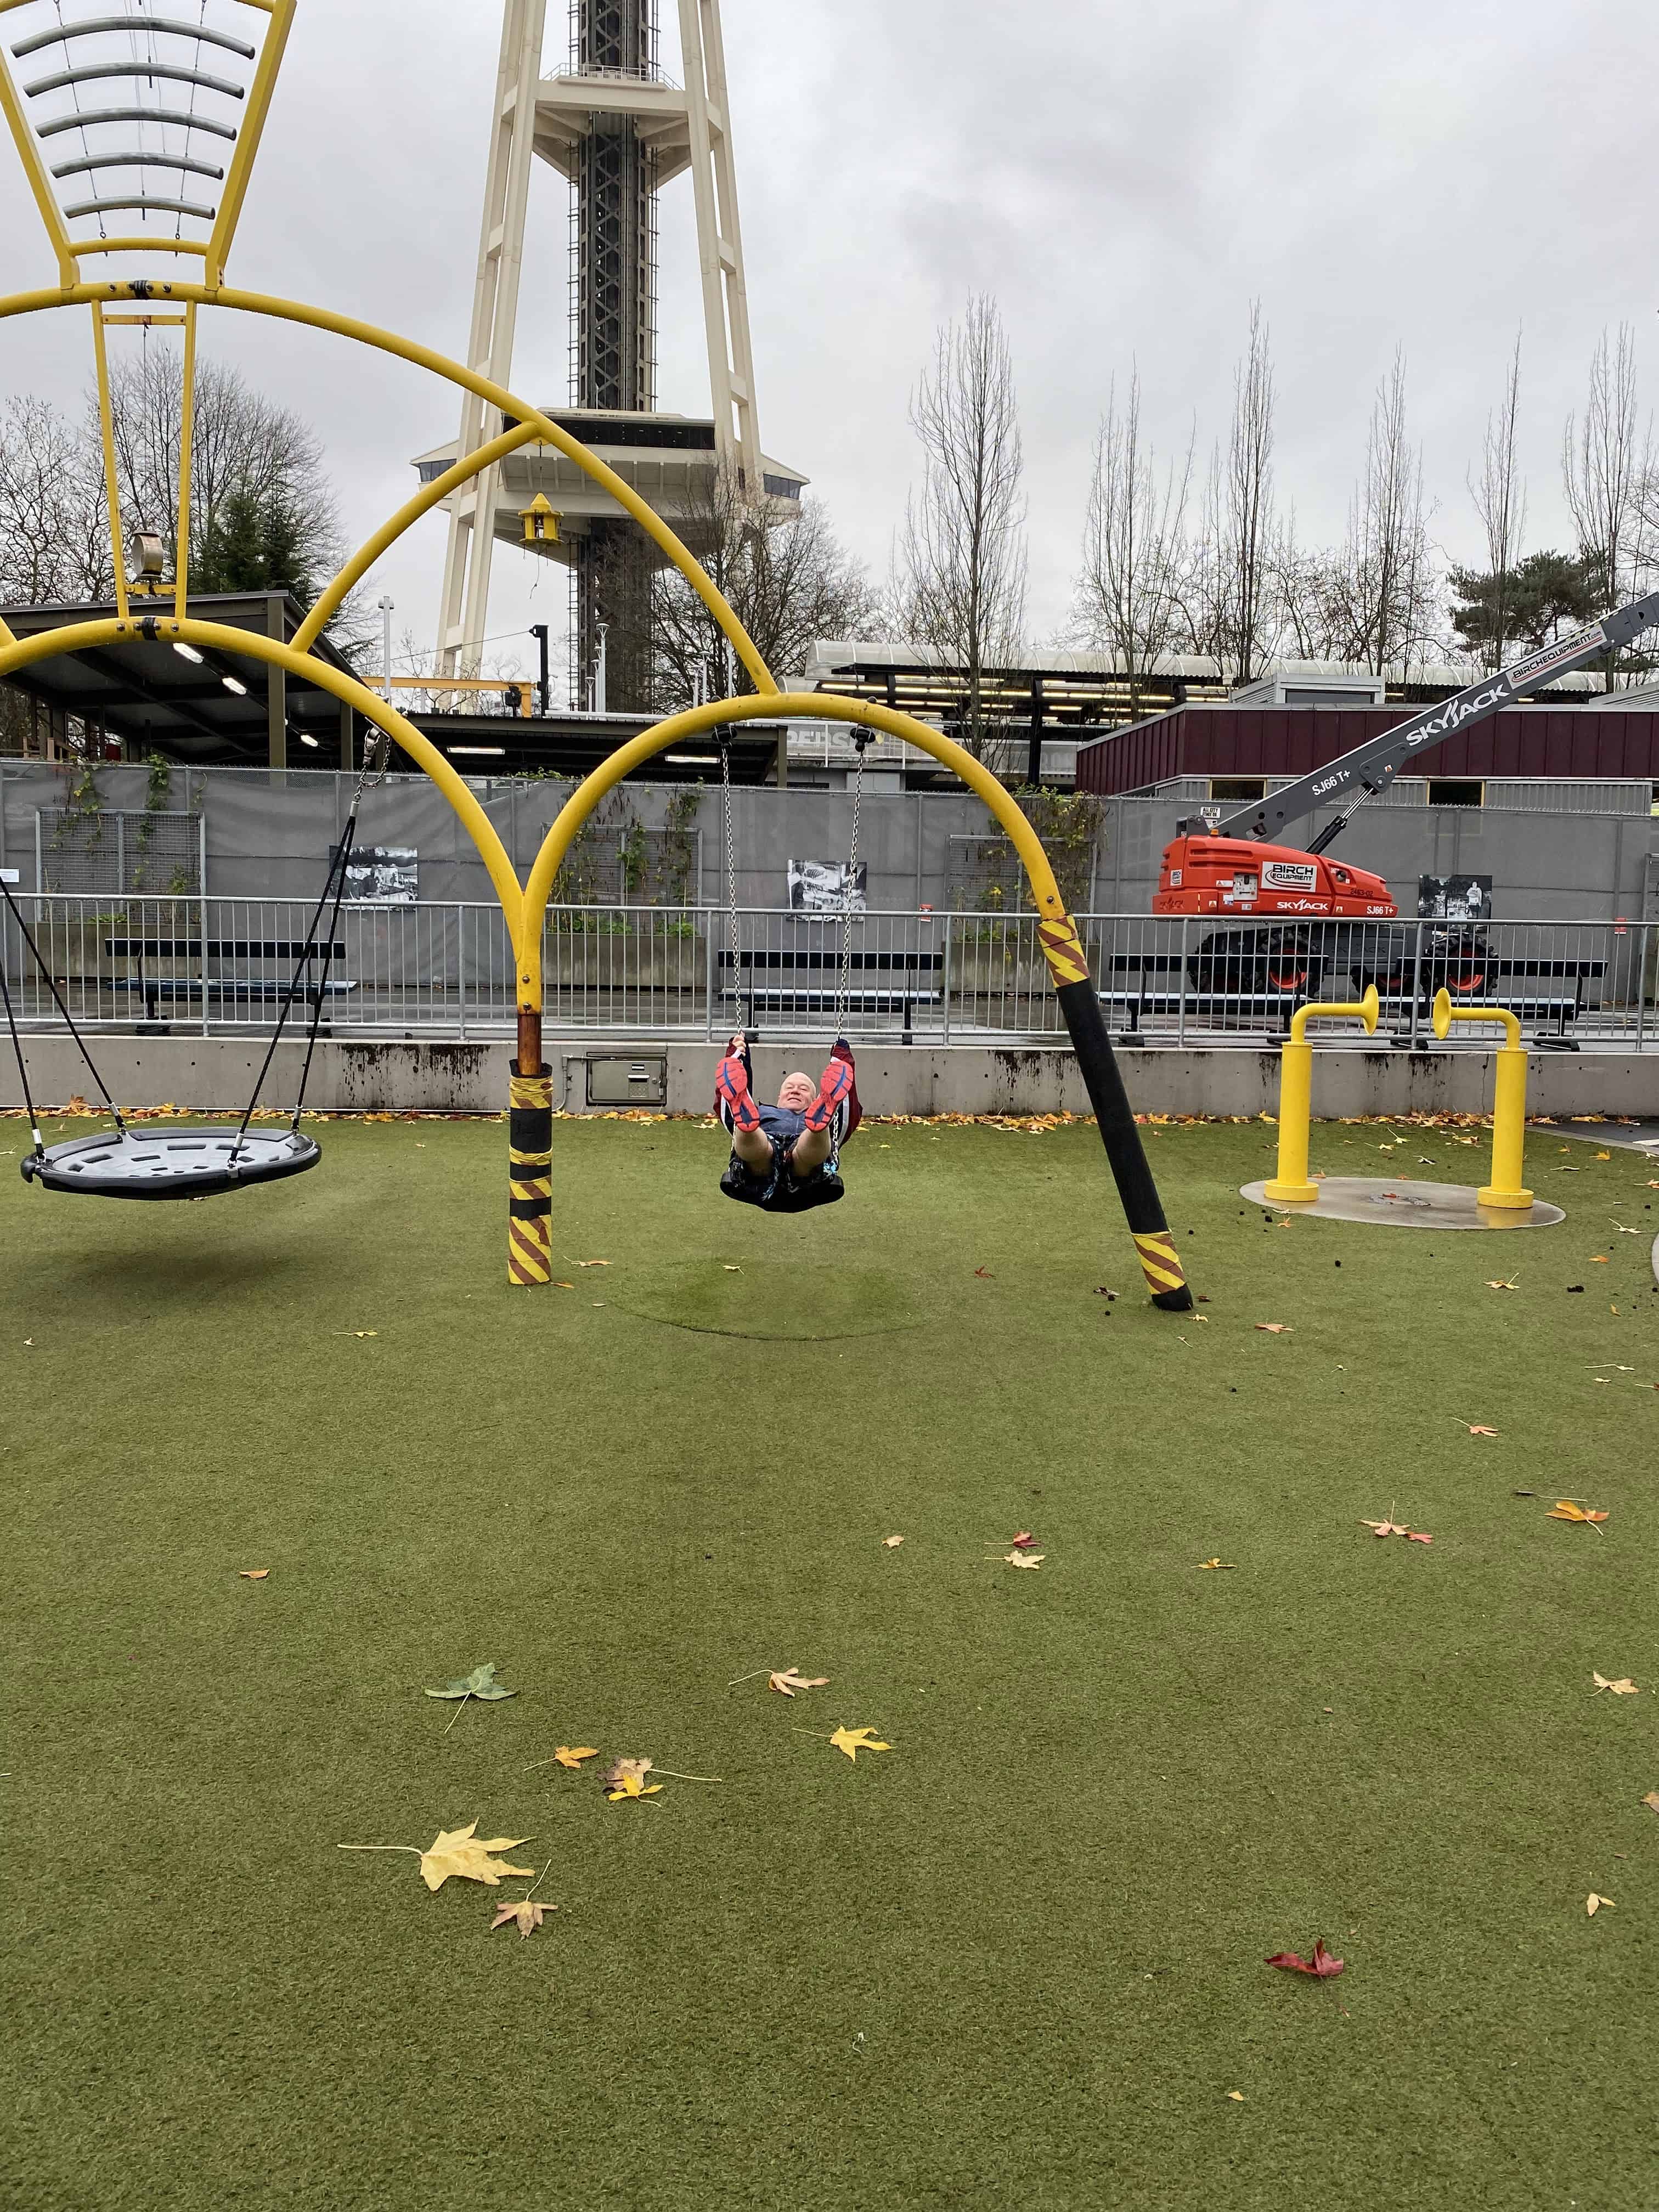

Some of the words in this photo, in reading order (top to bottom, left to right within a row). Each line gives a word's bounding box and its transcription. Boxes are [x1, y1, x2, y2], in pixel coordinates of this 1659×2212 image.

[1513, 631, 1601, 679] BIRCHEQUIPMENT.com
[1406, 684, 1509, 746] SKYJACK
[1312, 776, 1338, 795] SJ66
[1336, 770, 1351, 782] T+
[1273, 865, 1313, 875] BIRCH
[1277, 899, 1328, 911] SKYJACK
[1367, 906, 1384, 915] SJ66
[1384, 906, 1393, 915] T+
